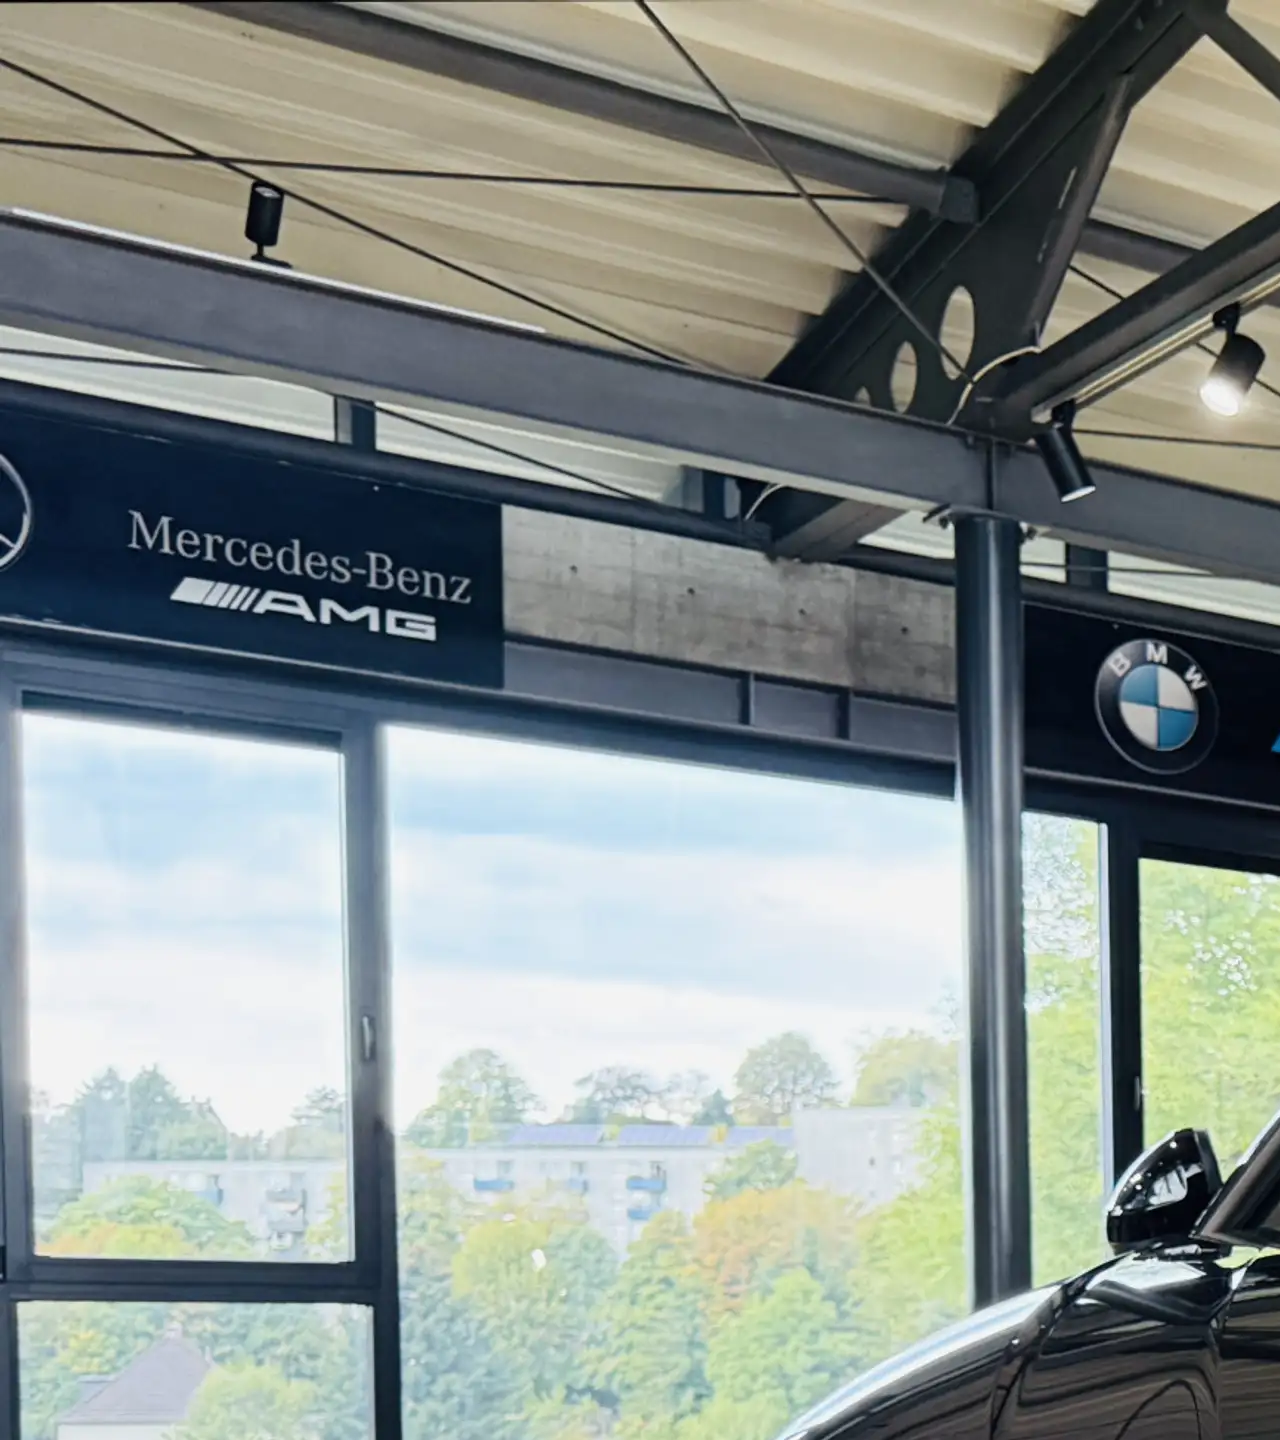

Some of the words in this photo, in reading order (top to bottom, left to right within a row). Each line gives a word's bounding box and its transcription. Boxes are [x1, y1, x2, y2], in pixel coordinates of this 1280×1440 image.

[127, 509, 472, 604] Mercedes-Benz
[253, 590, 437, 641] AMG
[1107, 643, 1207, 691] BMW
